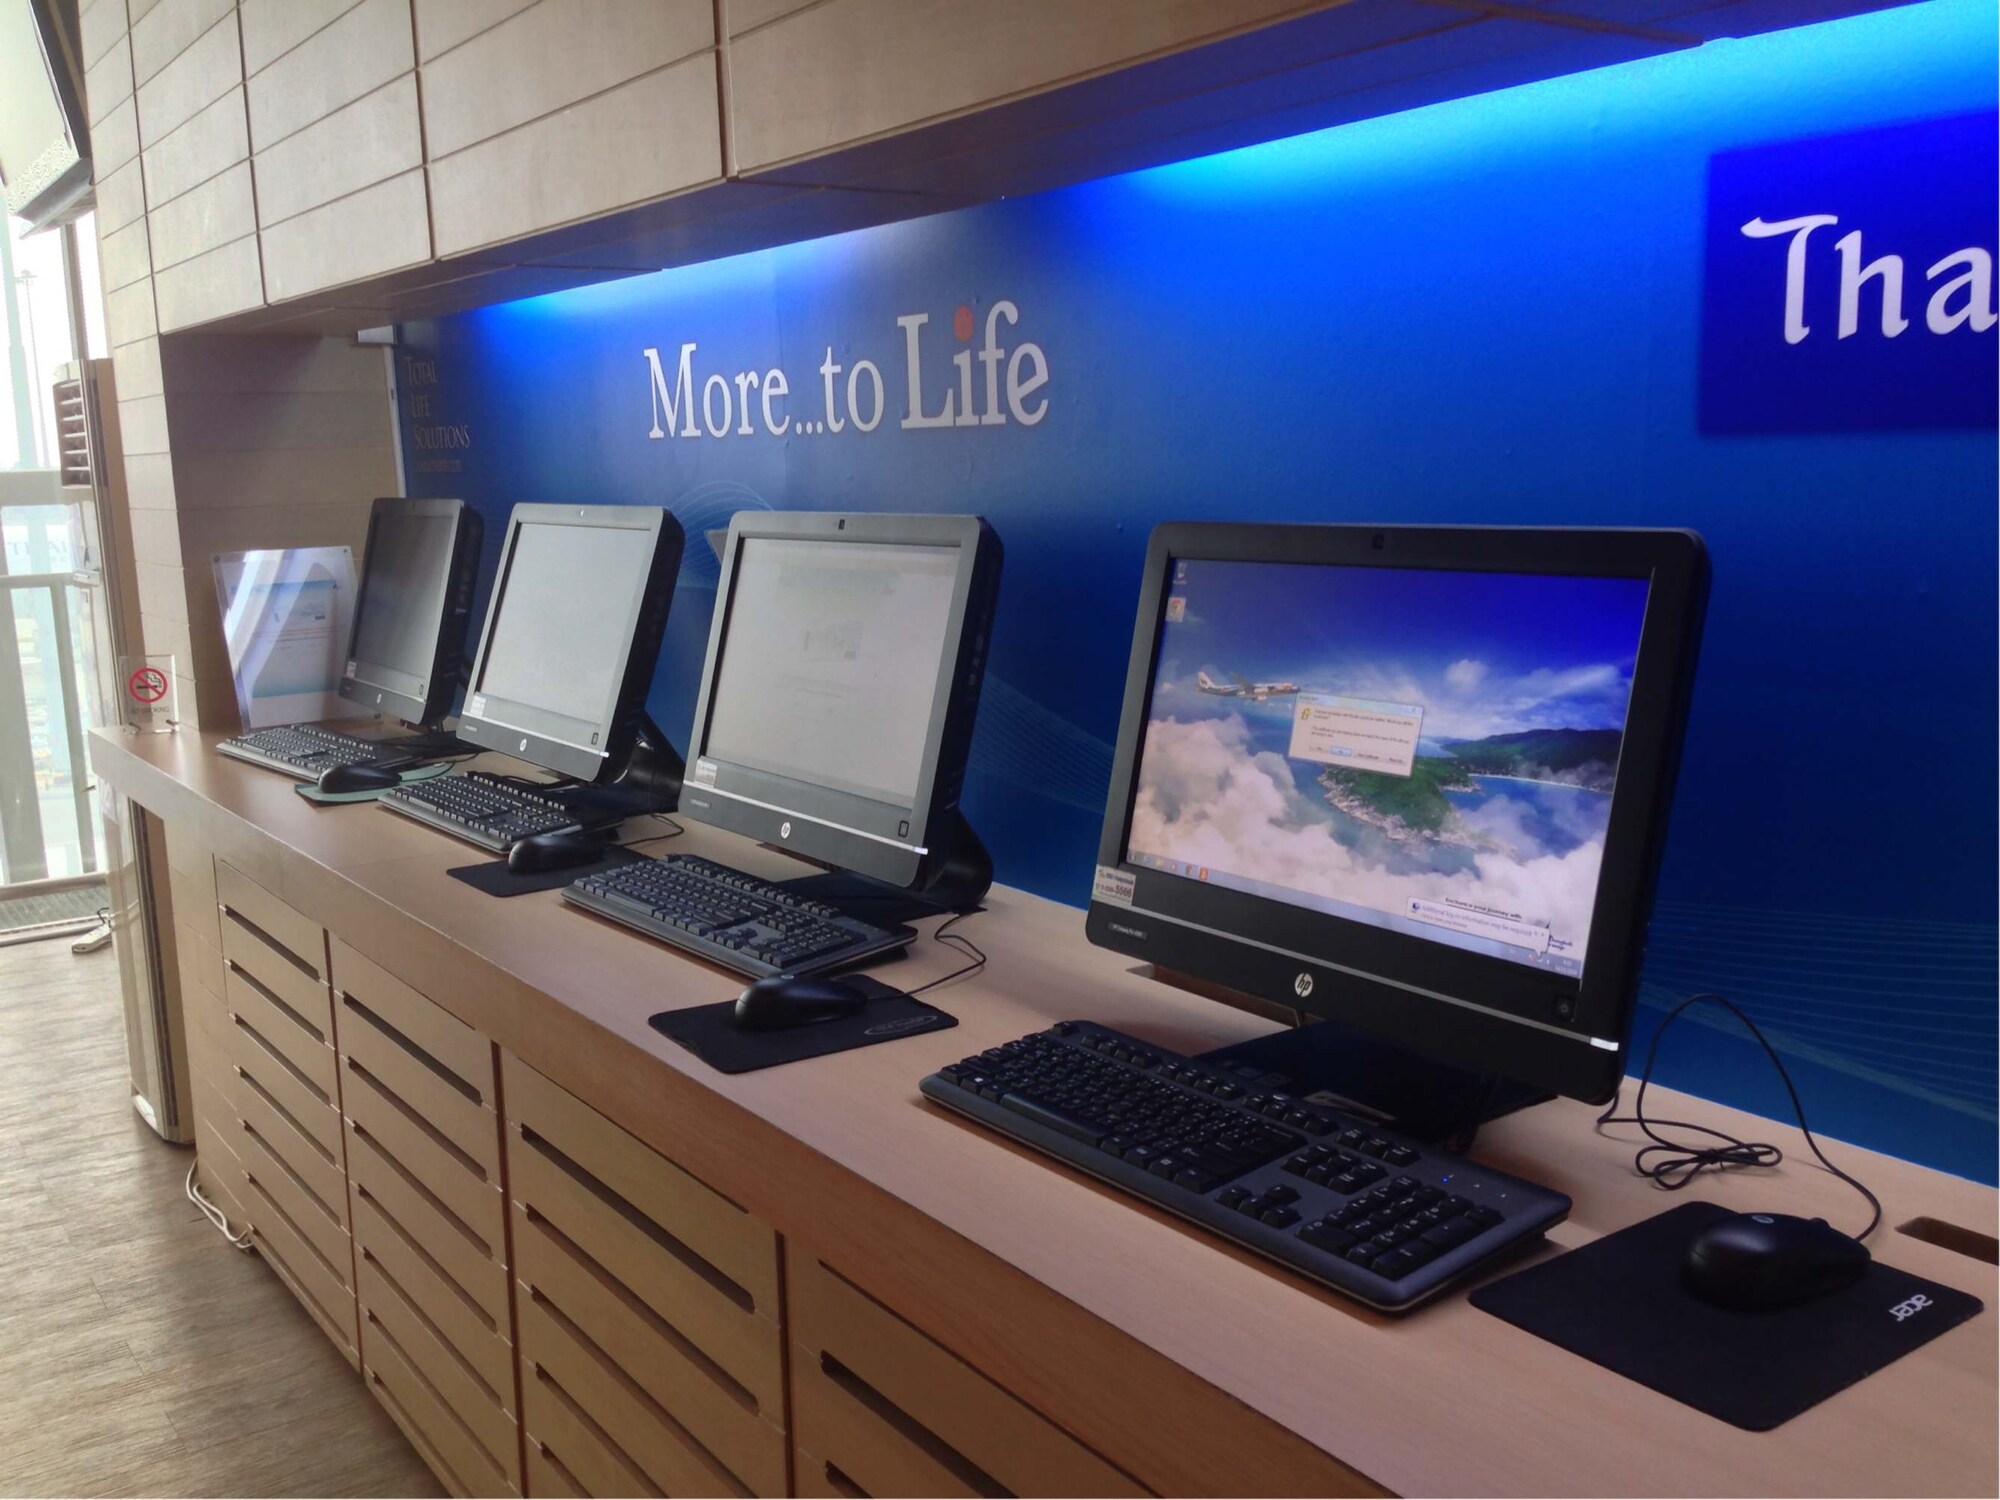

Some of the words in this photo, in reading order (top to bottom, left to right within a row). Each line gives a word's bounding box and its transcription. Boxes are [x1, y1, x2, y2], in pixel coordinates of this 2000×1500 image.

[1740, 213, 1998, 345] Tha
[405, 356, 438, 385] TOTAL
[897, 300, 1050, 429] Life
[411, 394, 431, 418] LIFE
[413, 424, 471, 449] SOLUTIONS
[1295, 972, 1313, 997] hp
[1888, 1294, 1933, 1322] acer
